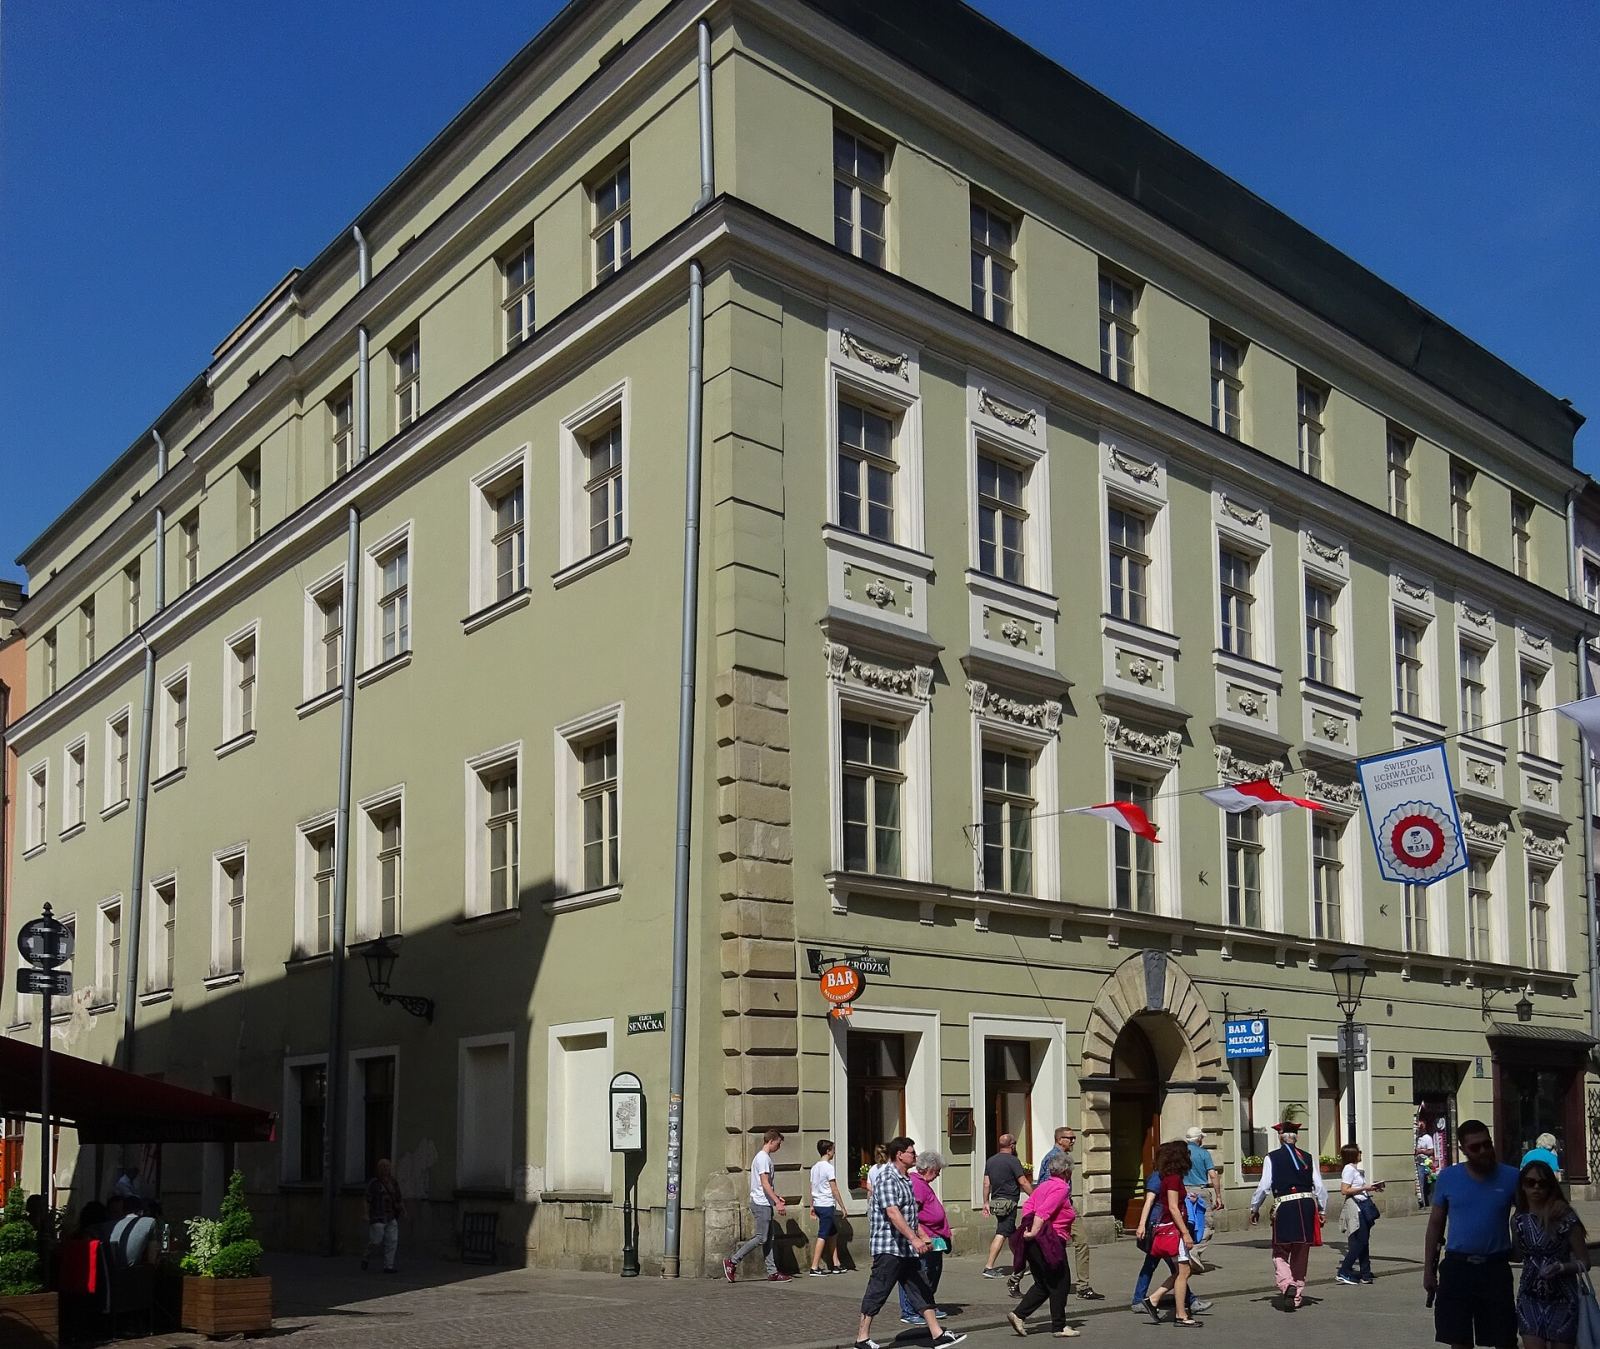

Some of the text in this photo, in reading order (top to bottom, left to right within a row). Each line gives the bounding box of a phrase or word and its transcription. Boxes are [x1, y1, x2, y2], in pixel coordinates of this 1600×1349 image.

[1373, 764, 1432, 783] UCHWALENIA
[1374, 772, 1435, 792] KONSTYTUCJI
[827, 970, 854, 988] BAR
[628, 1019, 664, 1032] SENACKA
[1228, 1024, 1247, 1034] BAR
[1228, 1035, 1264, 1045] MLECZNY
